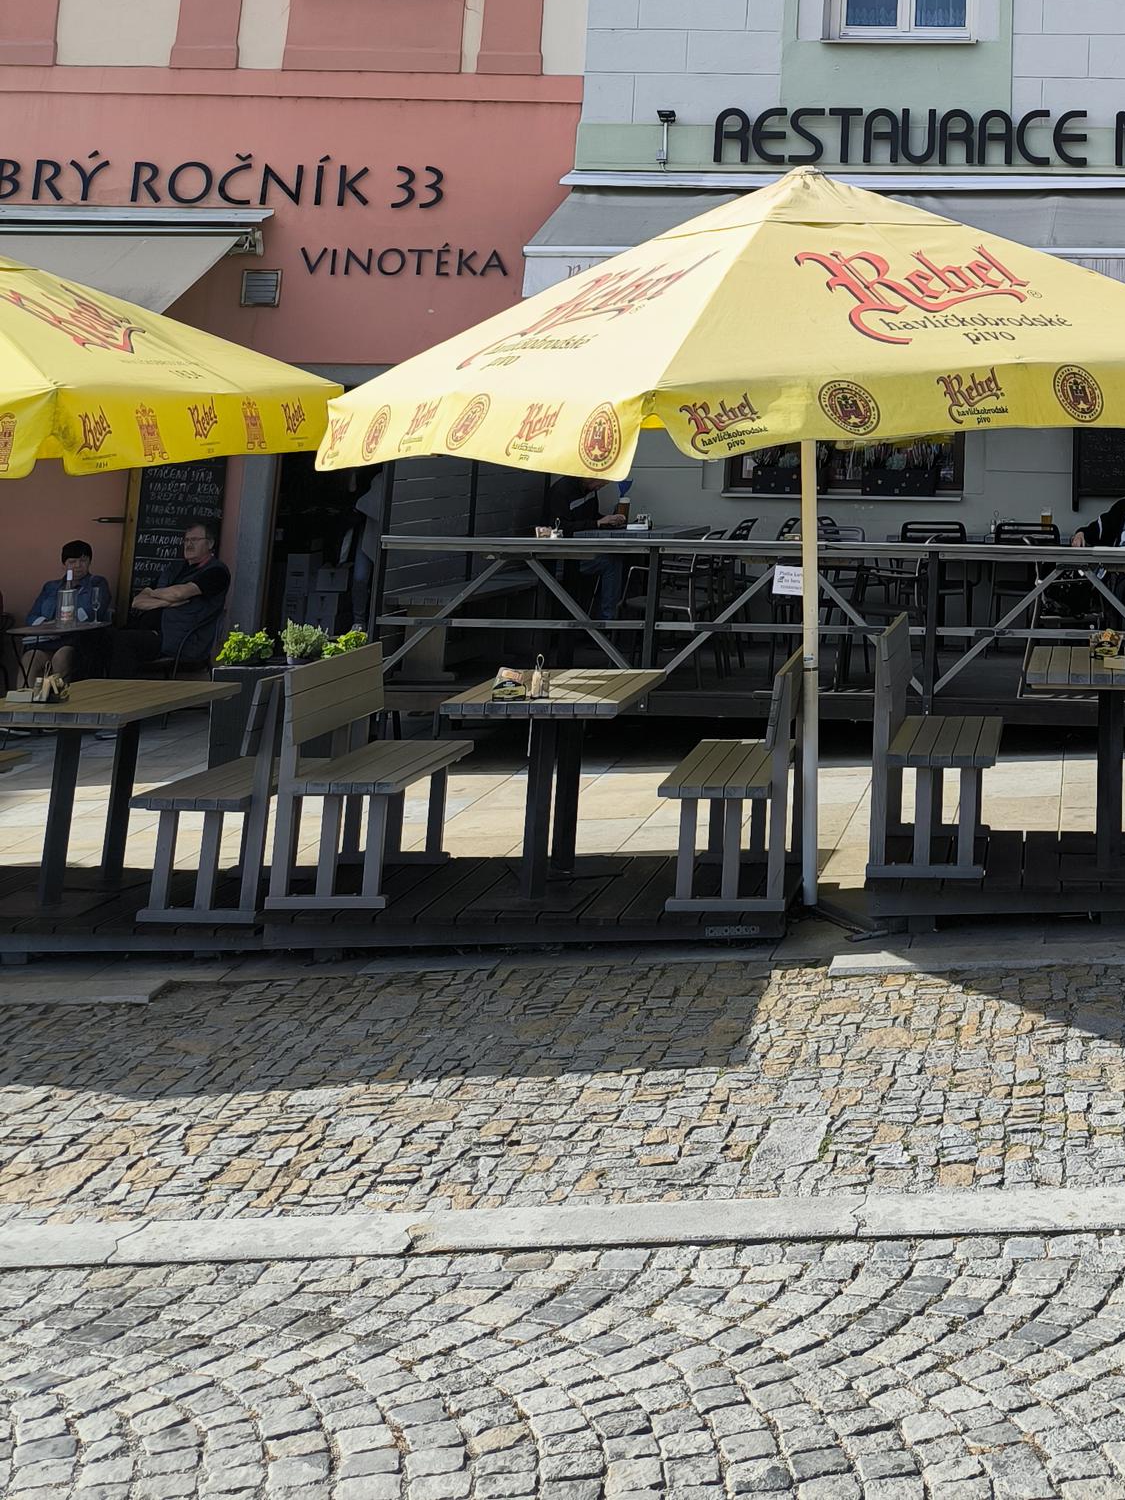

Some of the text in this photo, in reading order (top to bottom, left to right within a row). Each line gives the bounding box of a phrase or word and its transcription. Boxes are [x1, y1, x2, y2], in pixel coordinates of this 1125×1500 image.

[713, 107, 1088, 166] RESTAURACE
[130, 153, 370, 207] ROČNÍK
[390, 165, 445, 209] 33
[300, 242, 509, 277] VINOTÉKA
[793, 243, 1032, 345] Rebel
[879, 312, 1073, 332] havlíčkobrodské
[961, 327, 1017, 345] pivo
[936, 366, 1003, 425] Rebel
[679, 391, 760, 455] Rebel
[700, 425, 769, 448] havlíčkobrodské
[976, 416, 992, 425] pivo
[727, 438, 746, 451] pivo
